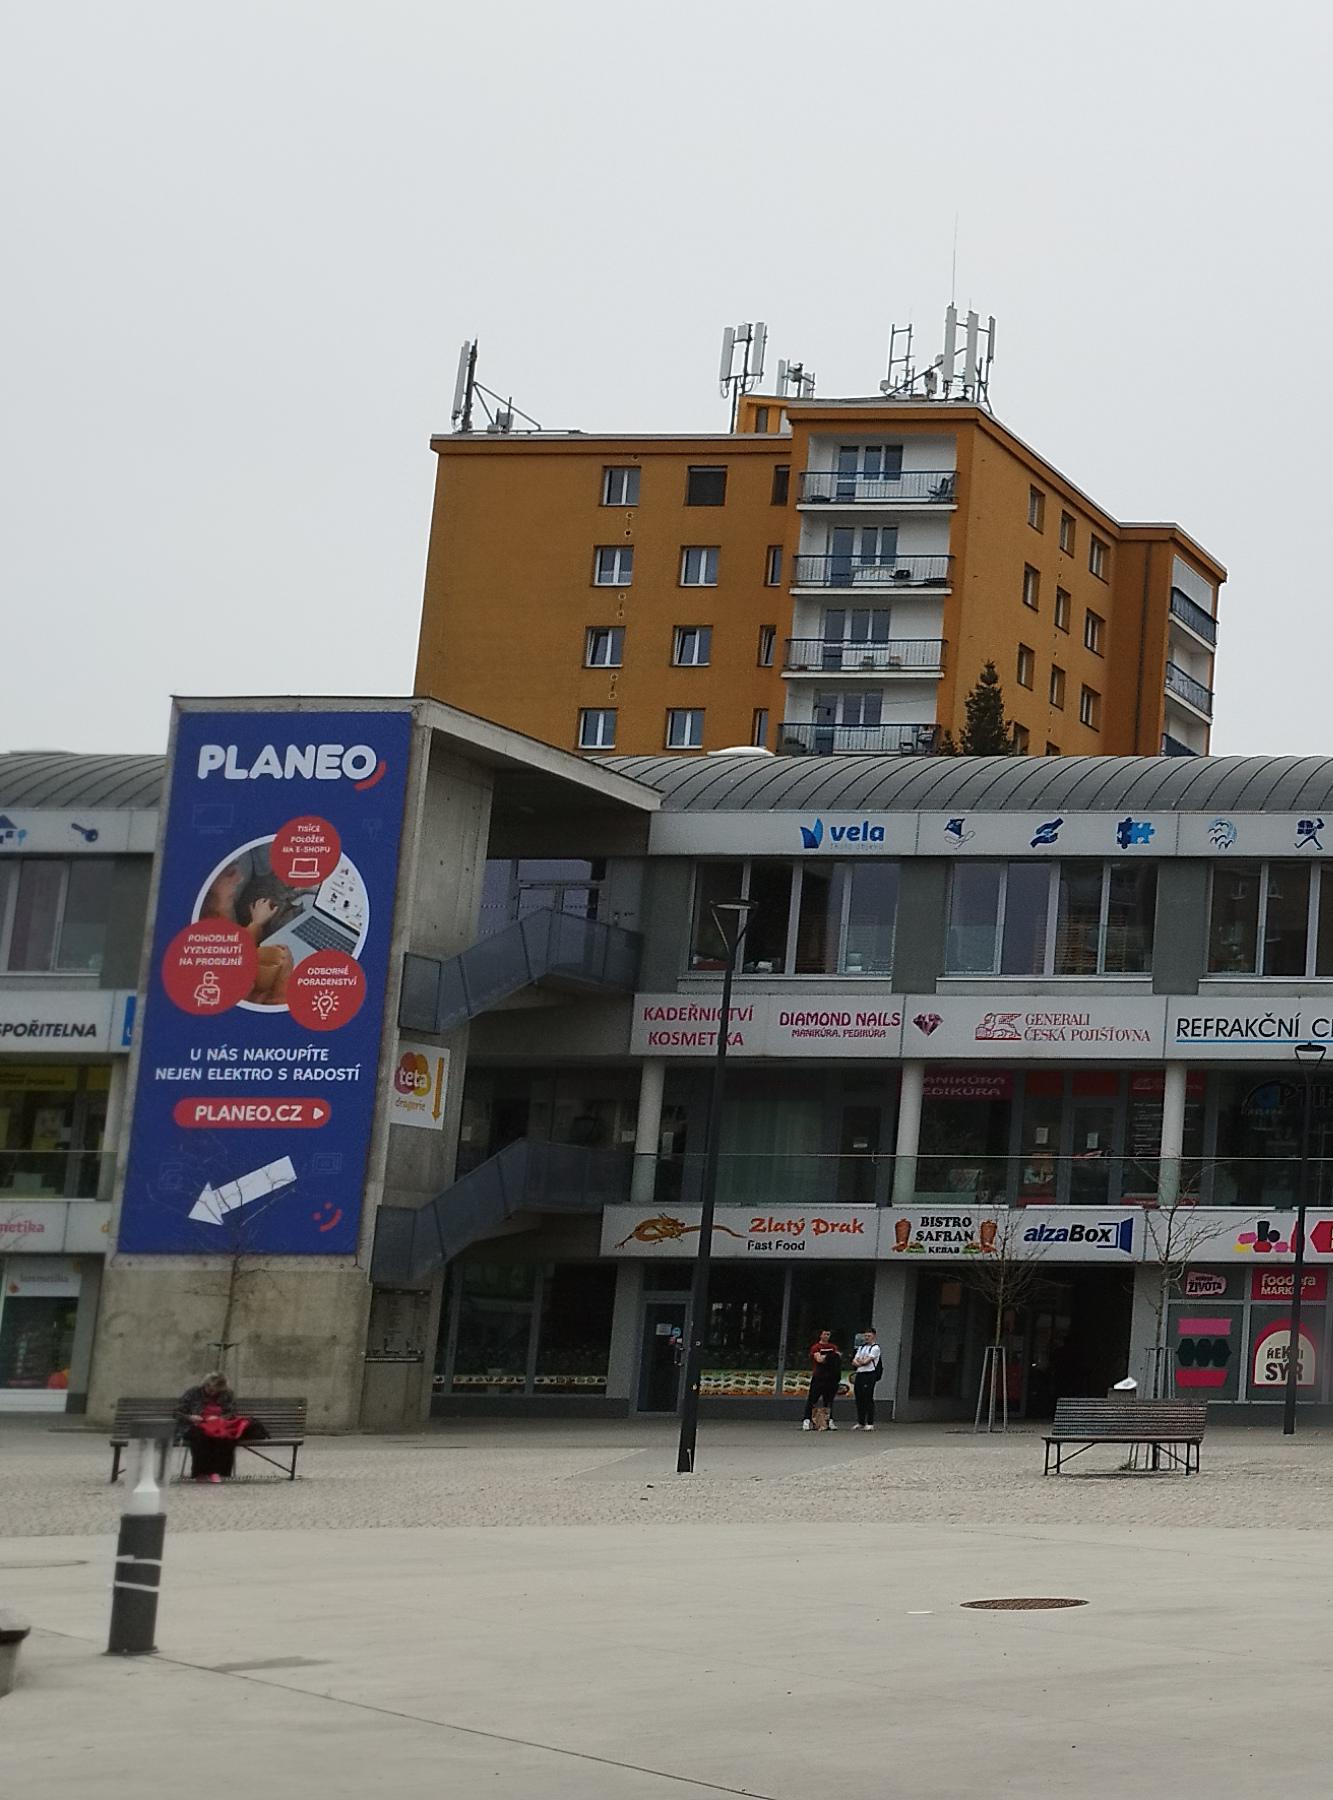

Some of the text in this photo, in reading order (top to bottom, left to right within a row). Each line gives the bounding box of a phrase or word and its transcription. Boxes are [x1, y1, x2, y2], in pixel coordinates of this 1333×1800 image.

[197, 744, 378, 781] PLANEO
[290, 833, 325, 844] POLOŽEK
[830, 820, 885, 842] vela
[188, 931, 240, 943] POHODLNÉ
[183, 943, 243, 955] VYZVEDNUTÍ
[178, 957, 193, 966] NA
[297, 975, 358, 987] PORADENSTVÍ
[779, 1012, 901, 1027] DIAMOND NAILS
[1025, 1013, 1091, 1026] GENERALI
[1176, 1012, 1300, 1039] REFRAKČNÍ
[0, 1019, 97, 1038] POŘITELNA
[1024, 1025, 1151, 1042] ČESKÁ POJIŠŤOVNA
[648, 1031, 744, 1046] KOSMETKA
[190, 1043, 330, 1062] U NÁS NAKOUPÍTE
[155, 1063, 361, 1081] NEJEN ELEKTRO S RADOSTÍ
[195, 1104, 303, 1123] PLANEO.CZ
[748, 1216, 865, 1236] Zlatý Drak
[919, 1215, 973, 1229] BISTRO
[914, 1229, 976, 1243] SAFRAN
[1022, 1221, 1112, 1244] alzaBox
[746, 1240, 806, 1251] Fast Food
[927, 1246, 962, 1255] KEBAB
[1261, 1273, 1317, 1287] foodra
